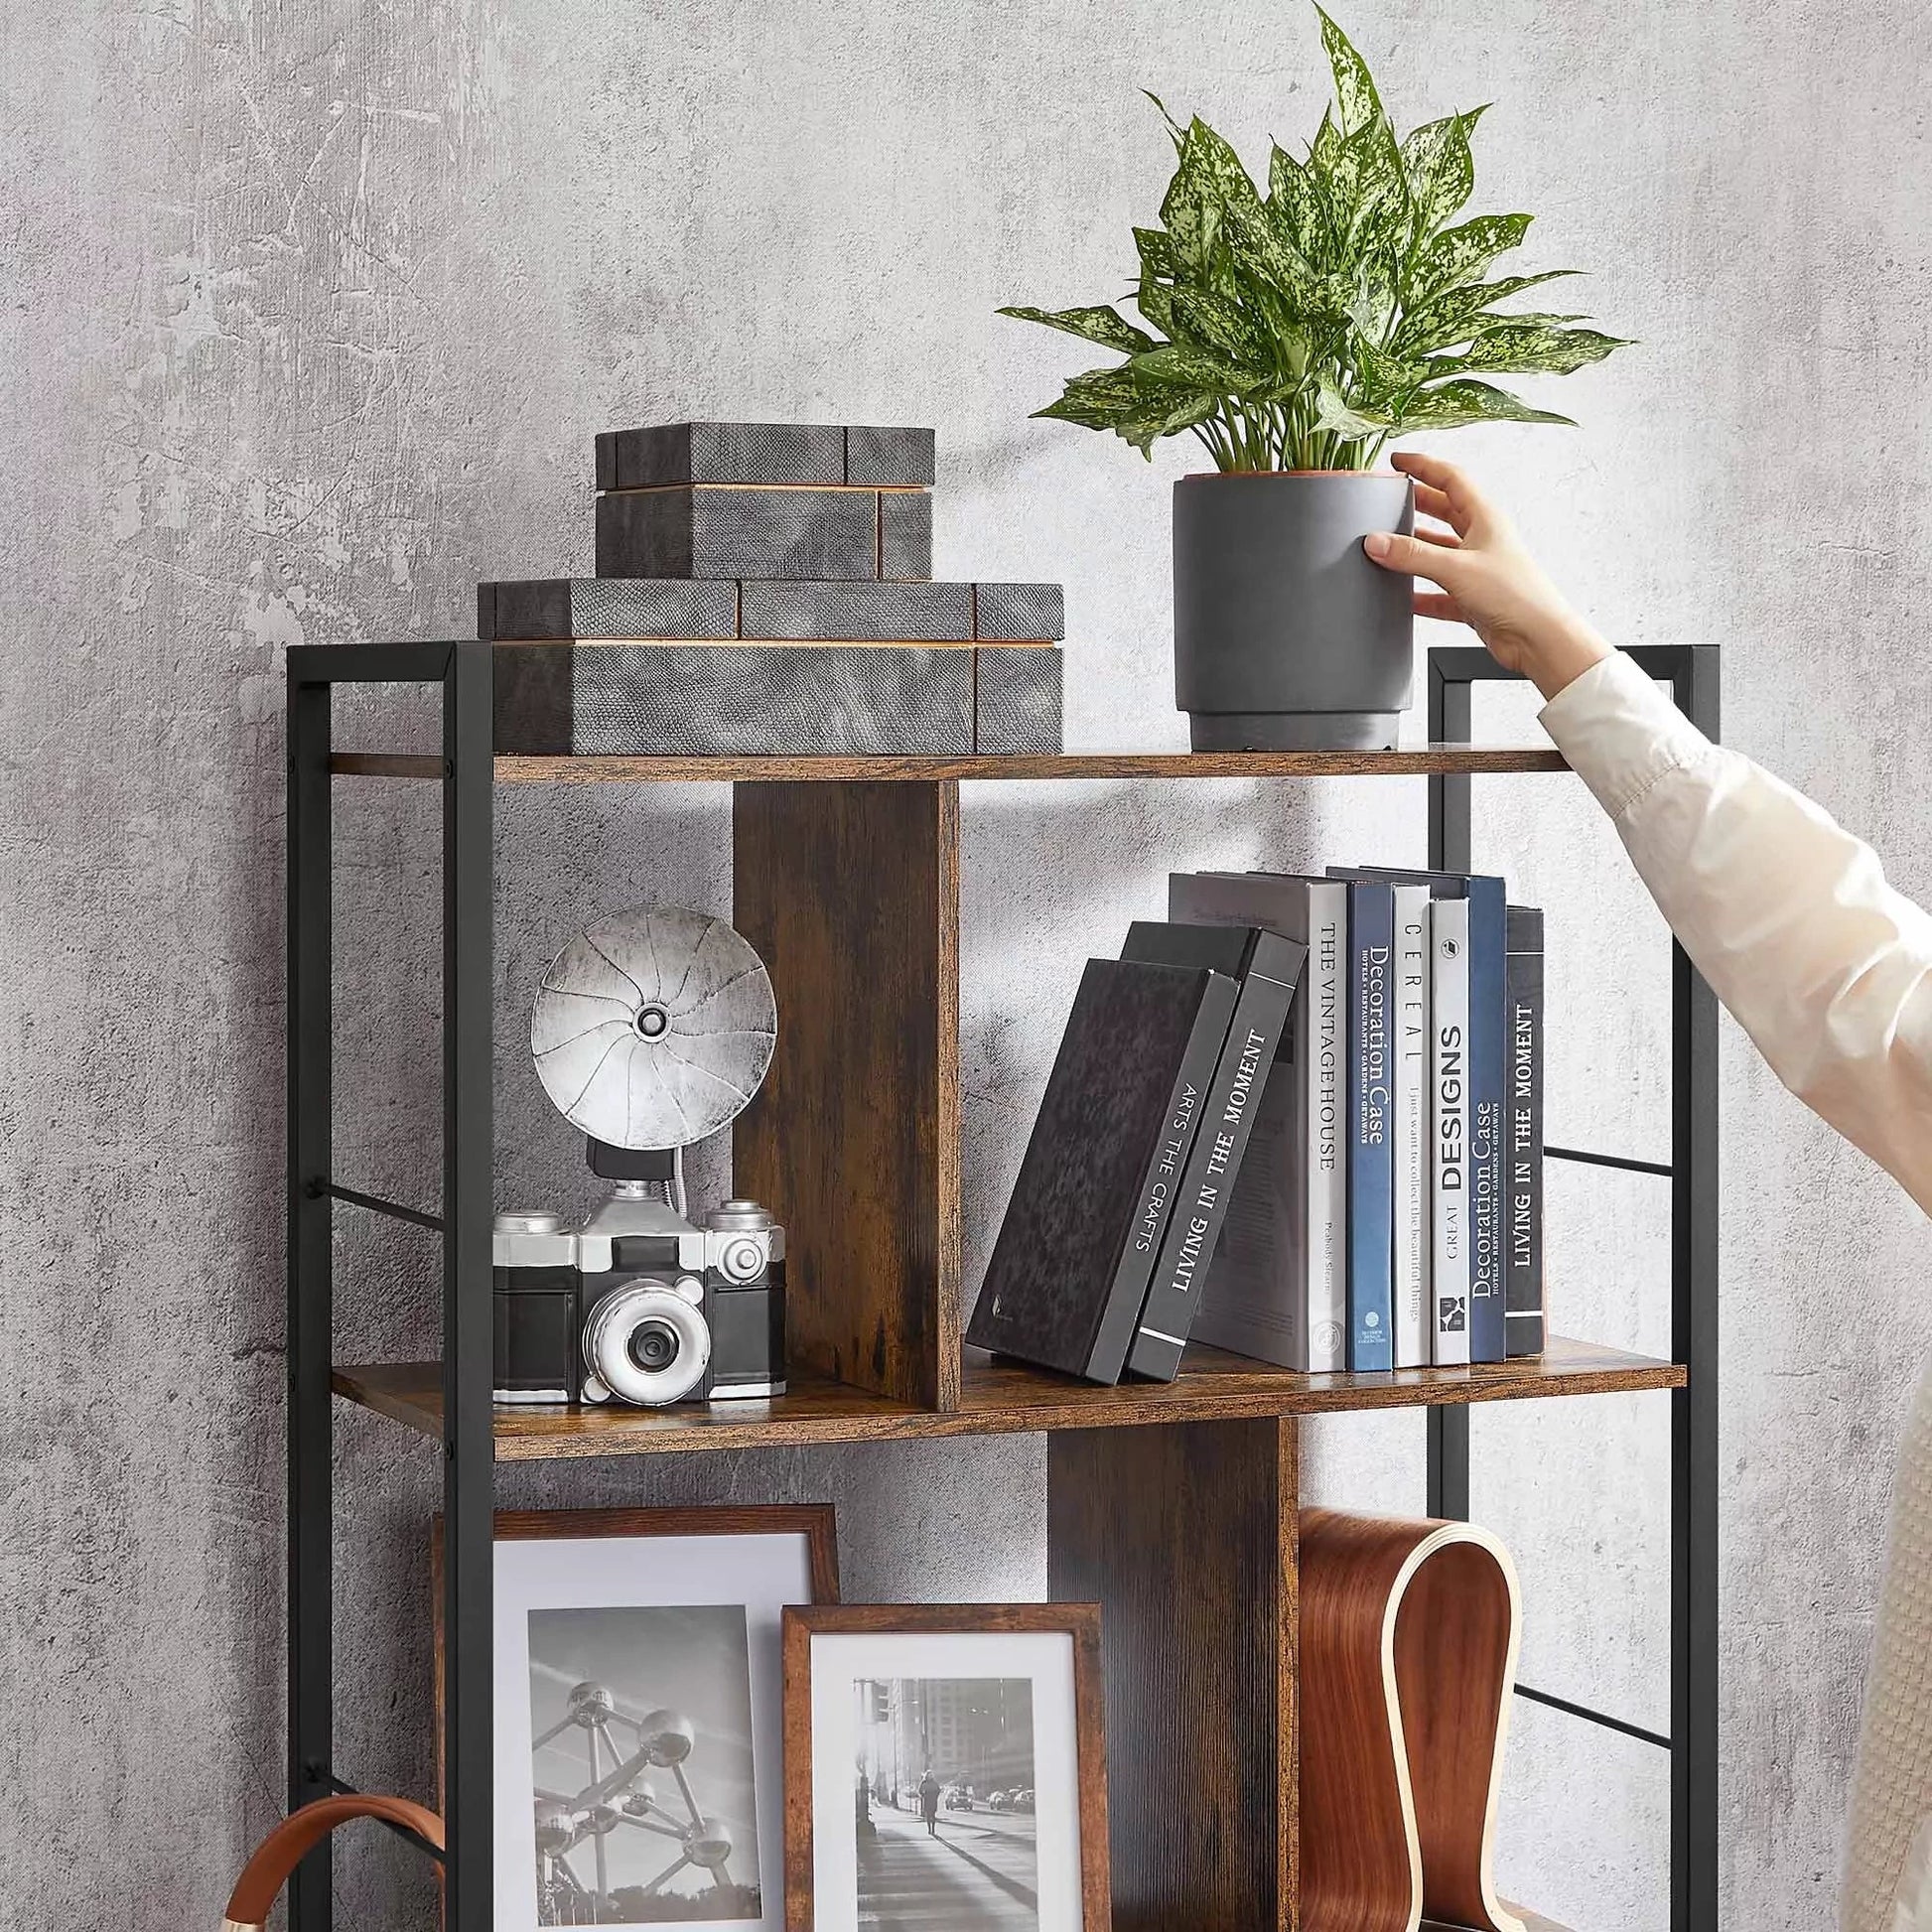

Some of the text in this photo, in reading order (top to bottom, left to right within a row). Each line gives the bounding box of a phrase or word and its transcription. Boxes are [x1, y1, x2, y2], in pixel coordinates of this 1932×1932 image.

[1319, 922, 1335, 1171] THE VINTAGE HOUSE
[1369, 945, 1391, 1145] Decoration Case
[1223, 1028, 1266, 1125] MOMENT
[1409, 1093, 1421, 1116] just
[1206, 1131, 1235, 1174] THE
[1411, 1119, 1420, 1149] want
[1411, 1151, 1420, 1164] to
[1441, 1026, 1461, 1260] GREAT DESIGNS
[1514, 1004, 1533, 1268] LIVING IN THE MOMENT
[1136, 1082, 1197, 1252] ARTS THE CRAFTS
[1410, 1166, 1421, 1204] collect
[1196, 1184, 1218, 1209] IN
[1411, 1205, 1421, 1226] the
[1471, 1102, 1491, 1300] Decoration Case
[1172, 1216, 1208, 1293] LIVING
[1411, 1229, 1422, 1282] beautiful
[1408, 1284, 1421, 1322] things
